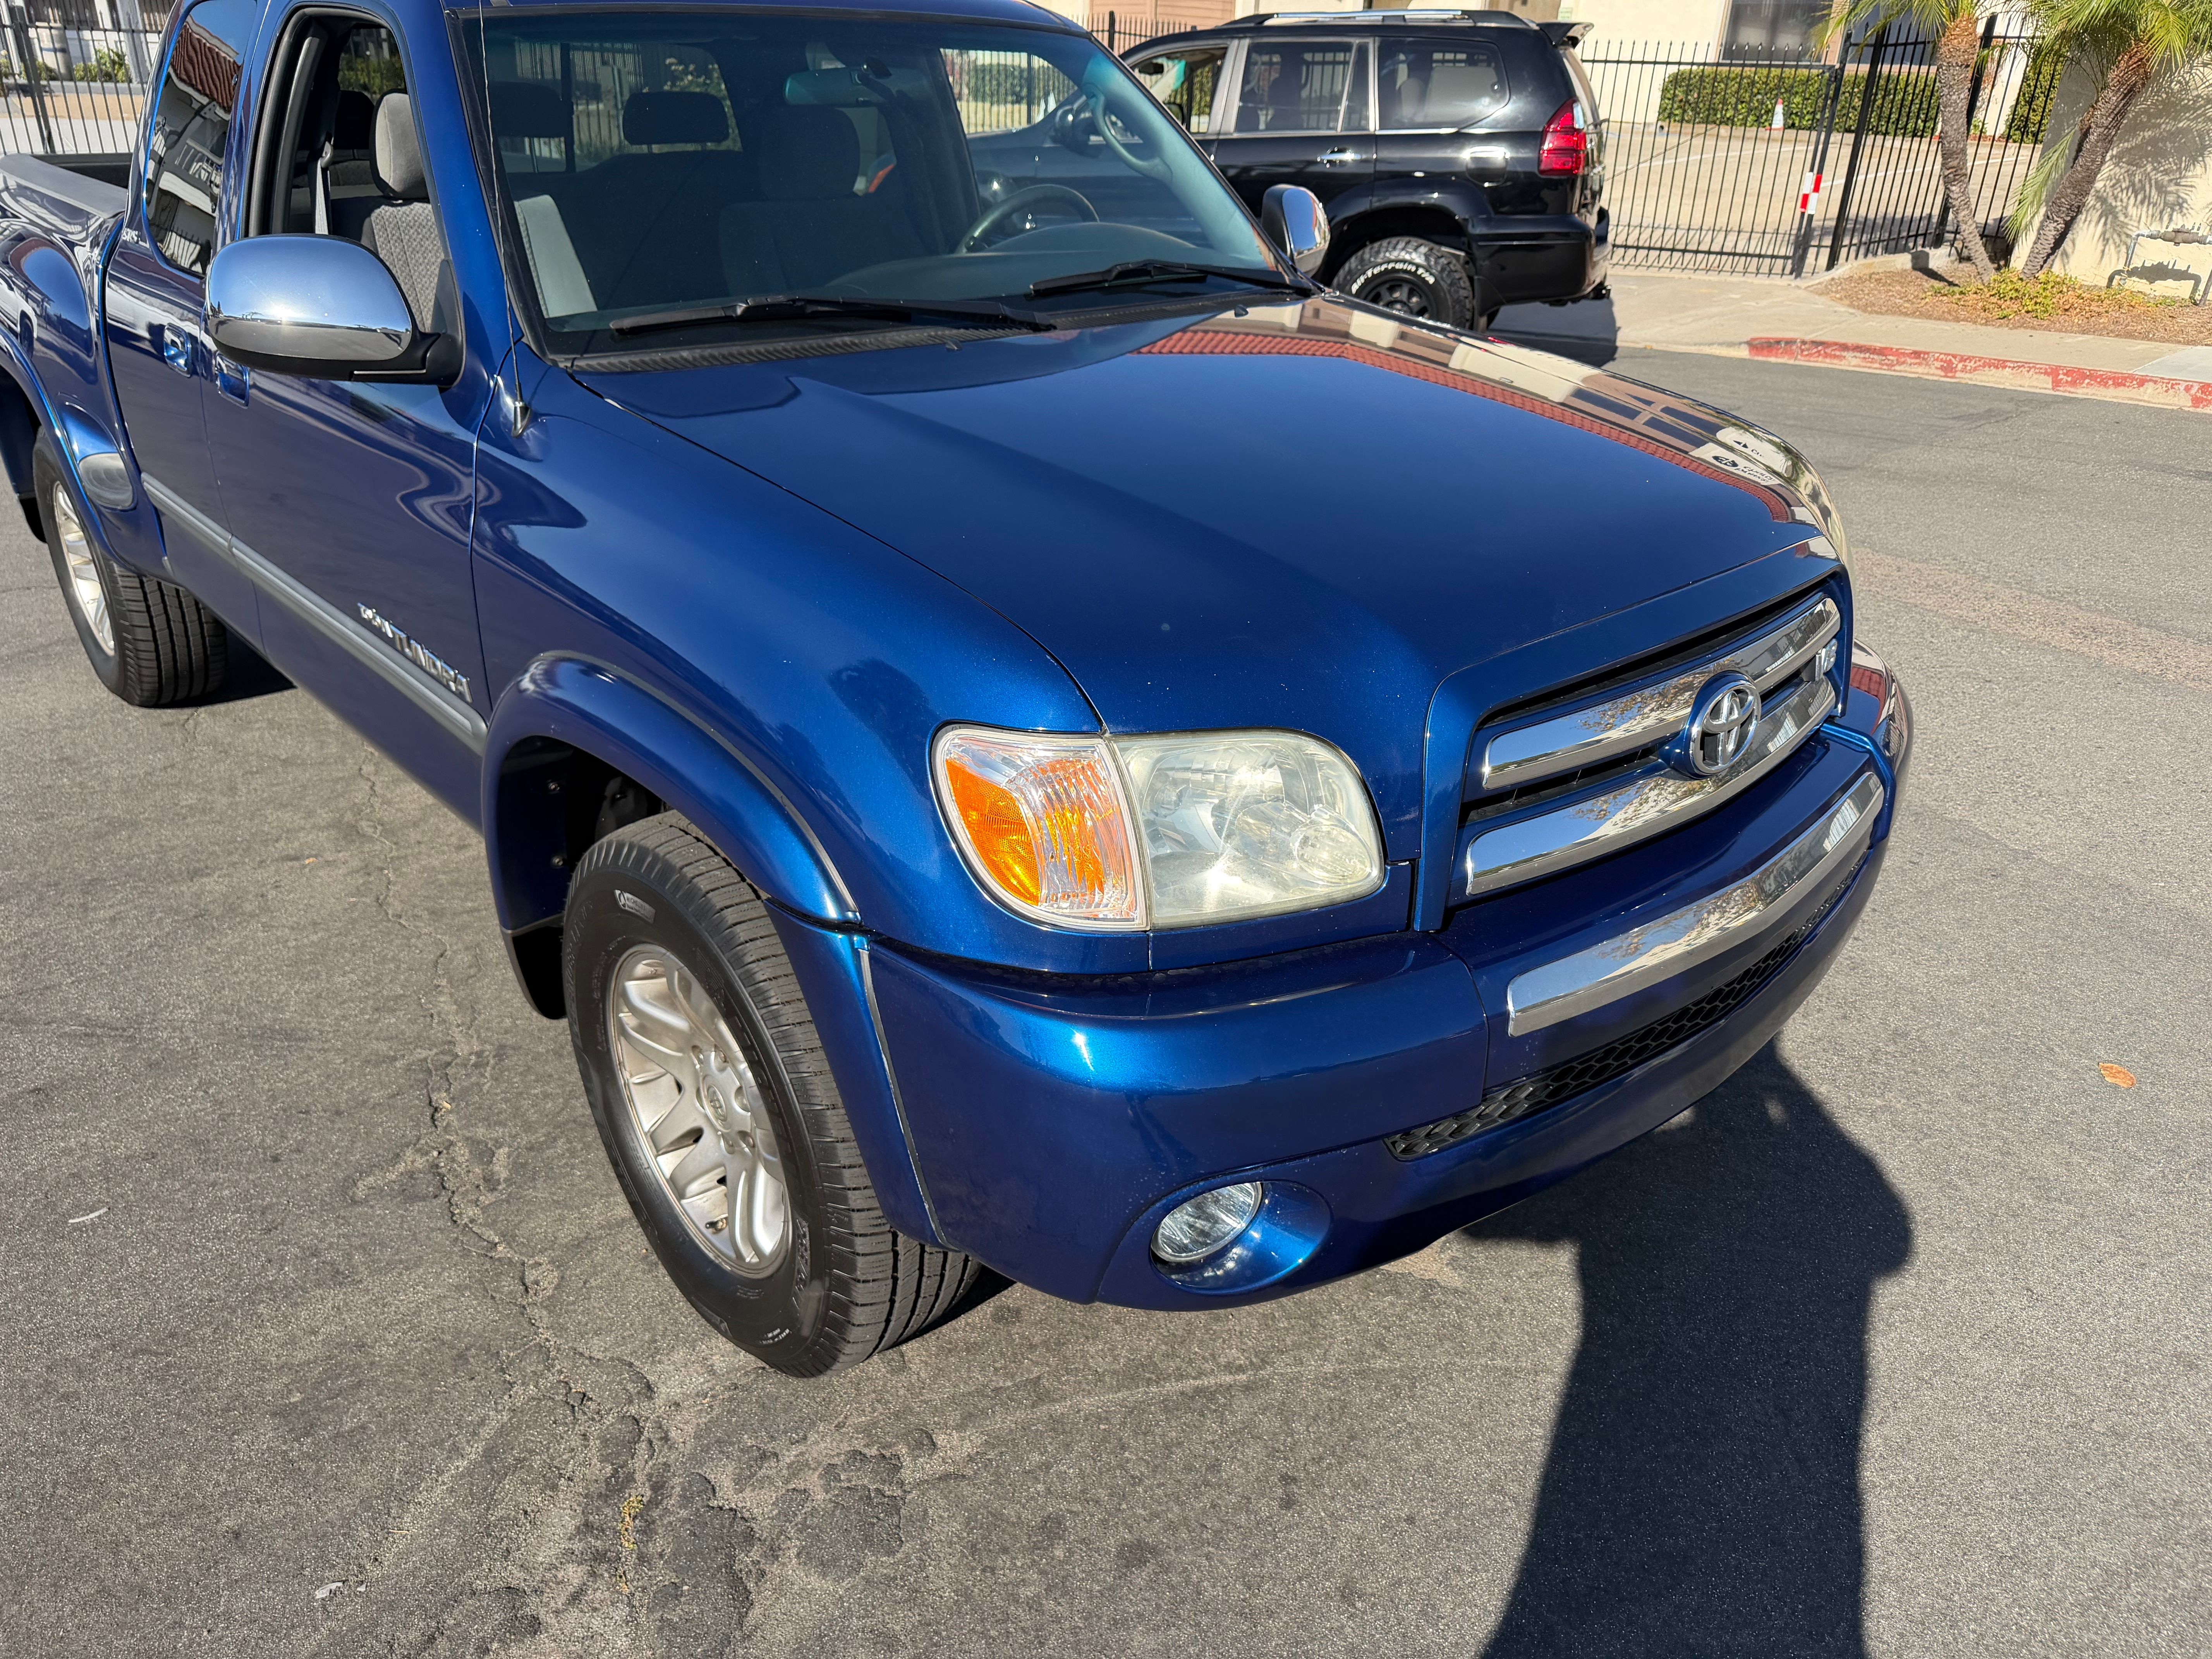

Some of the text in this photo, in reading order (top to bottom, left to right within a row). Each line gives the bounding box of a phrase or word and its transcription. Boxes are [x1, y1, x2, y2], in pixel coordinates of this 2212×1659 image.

[1352, 262, 1435, 294] All-Terrain T/A
[390, 623, 473, 703] TUNDRA
